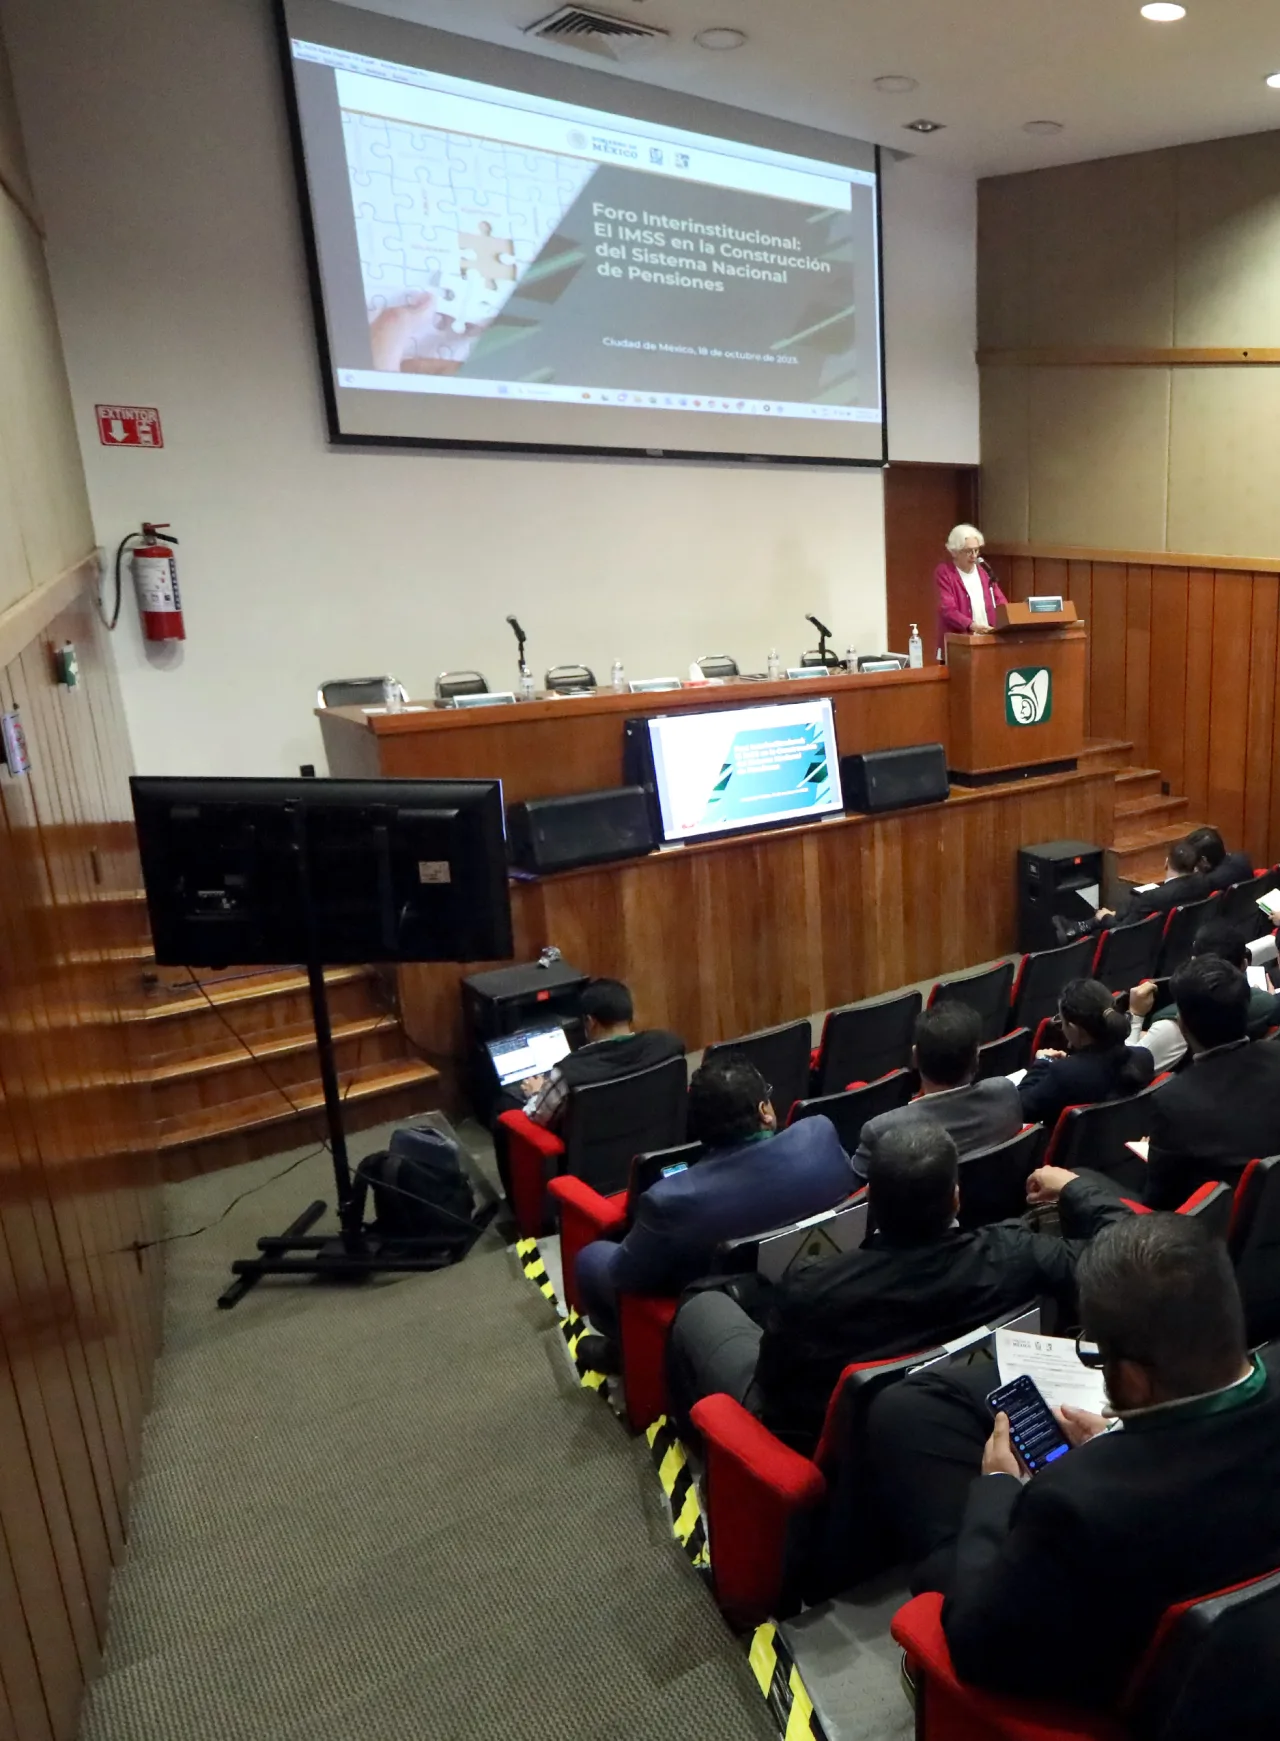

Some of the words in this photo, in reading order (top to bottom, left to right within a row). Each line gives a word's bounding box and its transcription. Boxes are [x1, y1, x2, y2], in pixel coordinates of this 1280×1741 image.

[592, 202, 637, 223] Foro
[643, 211, 801, 251] Interinstitucional:
[594, 222, 613, 239] El
[618, 226, 666, 247] IMSS
[671, 236, 694, 252] en
[700, 239, 715, 255] la
[720, 243, 830, 273] Construcción
[595, 243, 626, 260] del
[632, 248, 708, 273] Sistema
[712, 260, 788, 284] Nacional
[597, 262, 623, 278] de
[628, 266, 725, 292] Pensiones
[602, 336, 641, 350] Ciudad
[643, 342, 657, 352] de
[710, 347, 723, 358] de
[724, 351, 762, 362] octubre
[763, 352, 775, 363] de
[102, 408, 156, 422] EXTINTOR
